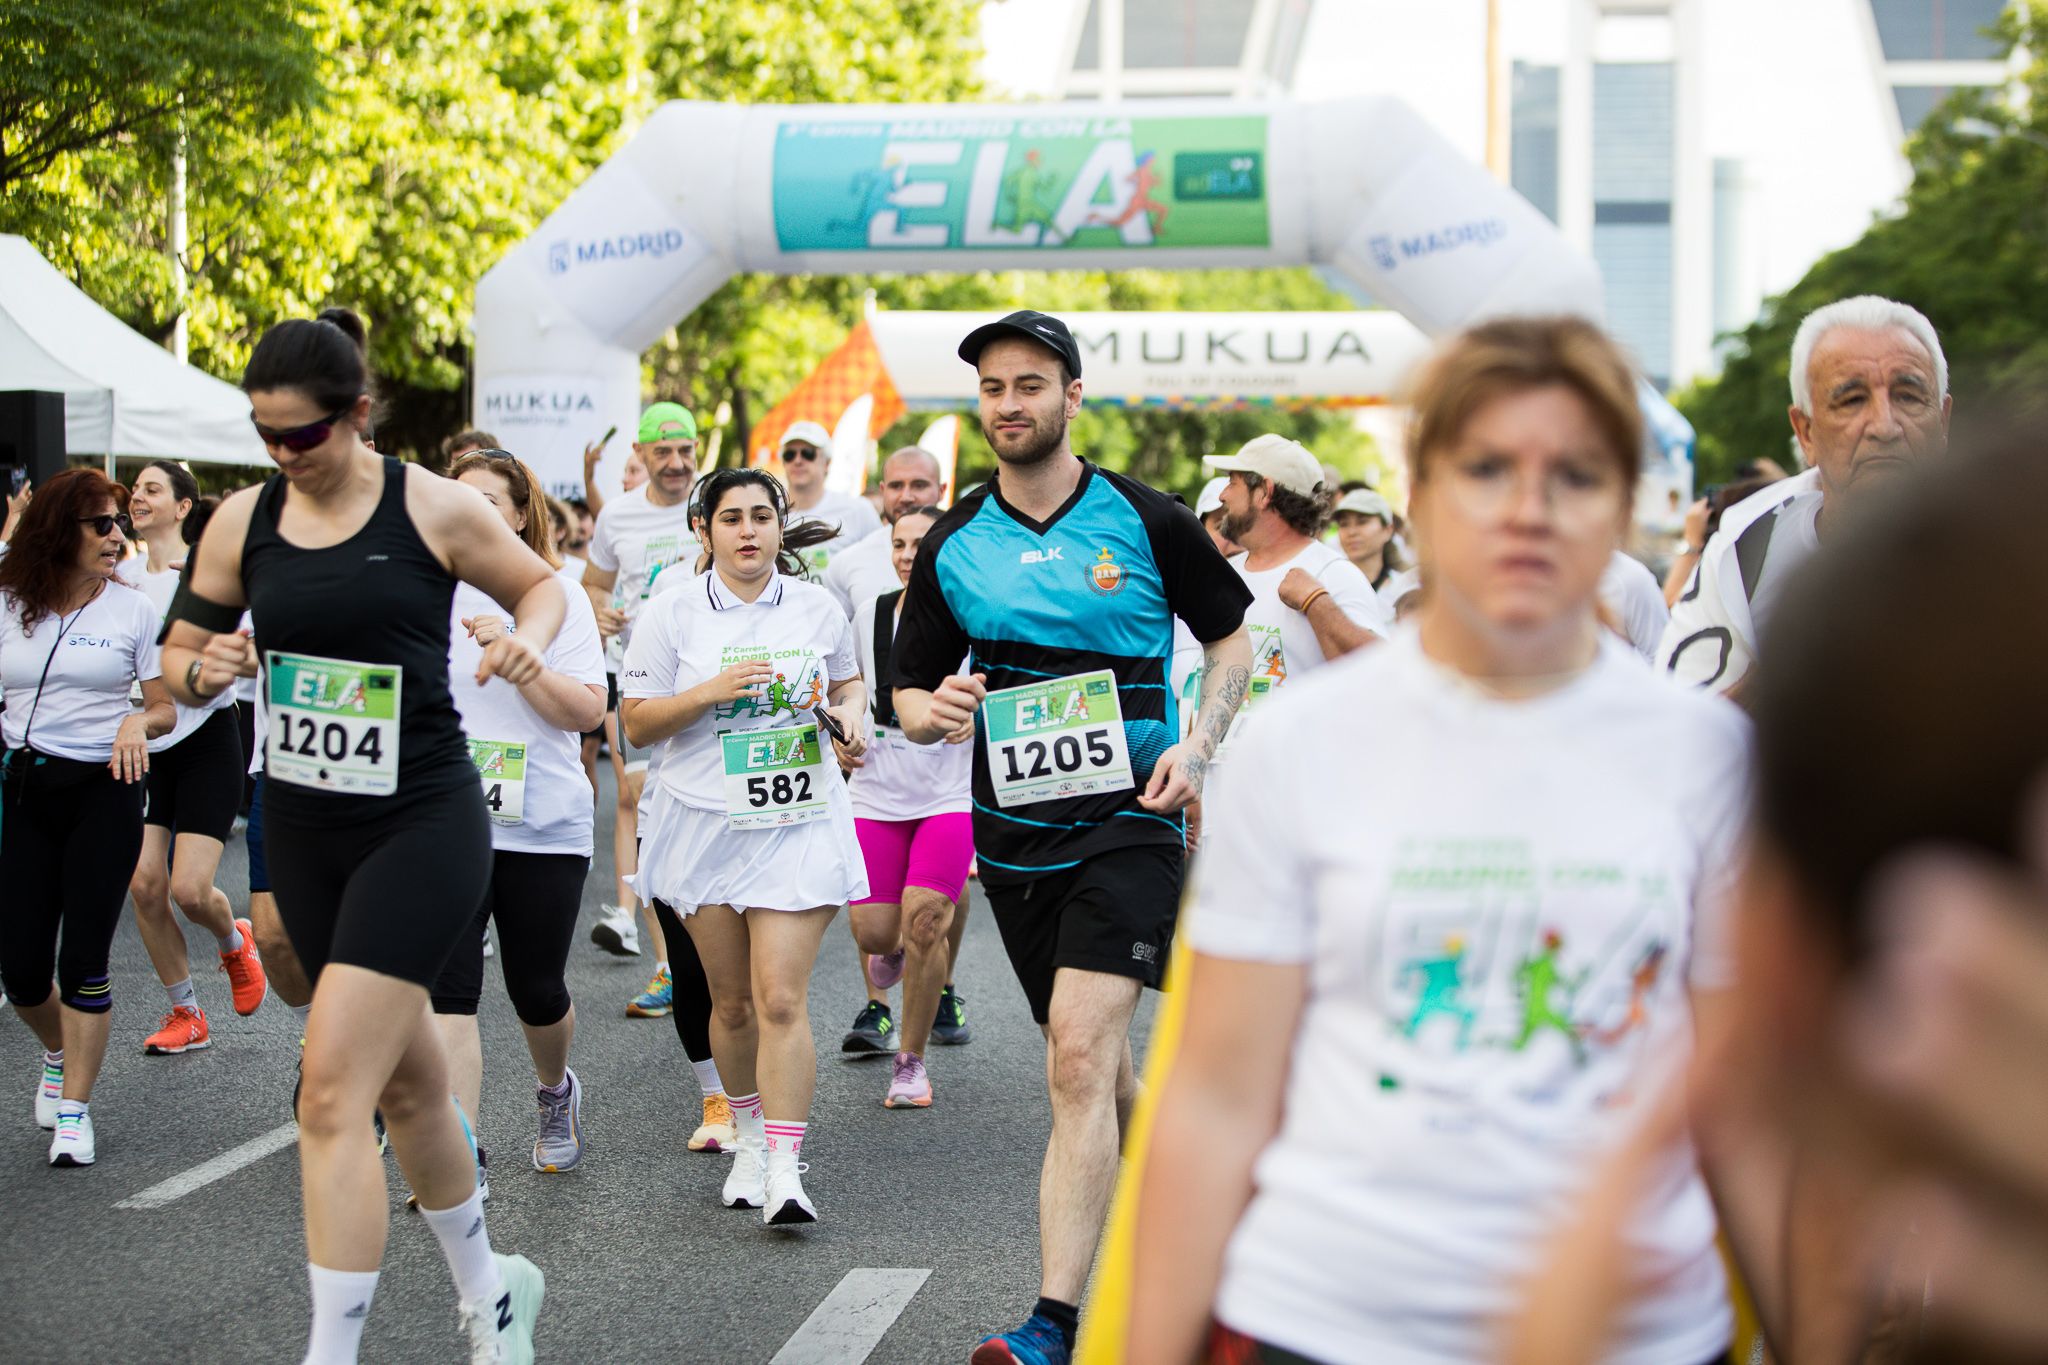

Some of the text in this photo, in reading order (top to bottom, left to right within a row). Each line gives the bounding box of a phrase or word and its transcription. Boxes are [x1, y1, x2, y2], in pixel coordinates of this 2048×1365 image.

[889, 119, 1014, 140] MADRID
[1019, 118, 1087, 137] CON
[1091, 117, 1133, 137] LA
[867, 139, 1156, 247] ELA
[577, 229, 683, 262] MADRID
[1401, 219, 1508, 258] MADRID
[1072, 330, 1371, 364] MUKUA
[486, 392, 595, 412] MUKUA
[1020, 546, 1064, 564] BLK
[1266, 626, 1280, 634] LA
[721, 648, 815, 664] MADRID CON LA
[291, 669, 366, 713] ELA
[1015, 687, 1047, 700] MADRID
[1048, 685, 1066, 693] CON
[1015, 690, 1089, 733] ELA
[279, 713, 383, 765] 1204
[747, 737, 806, 769] ELA
[1001, 729, 1113, 782] 1205
[484, 784, 502, 811] 4
[747, 771, 812, 808] 582
